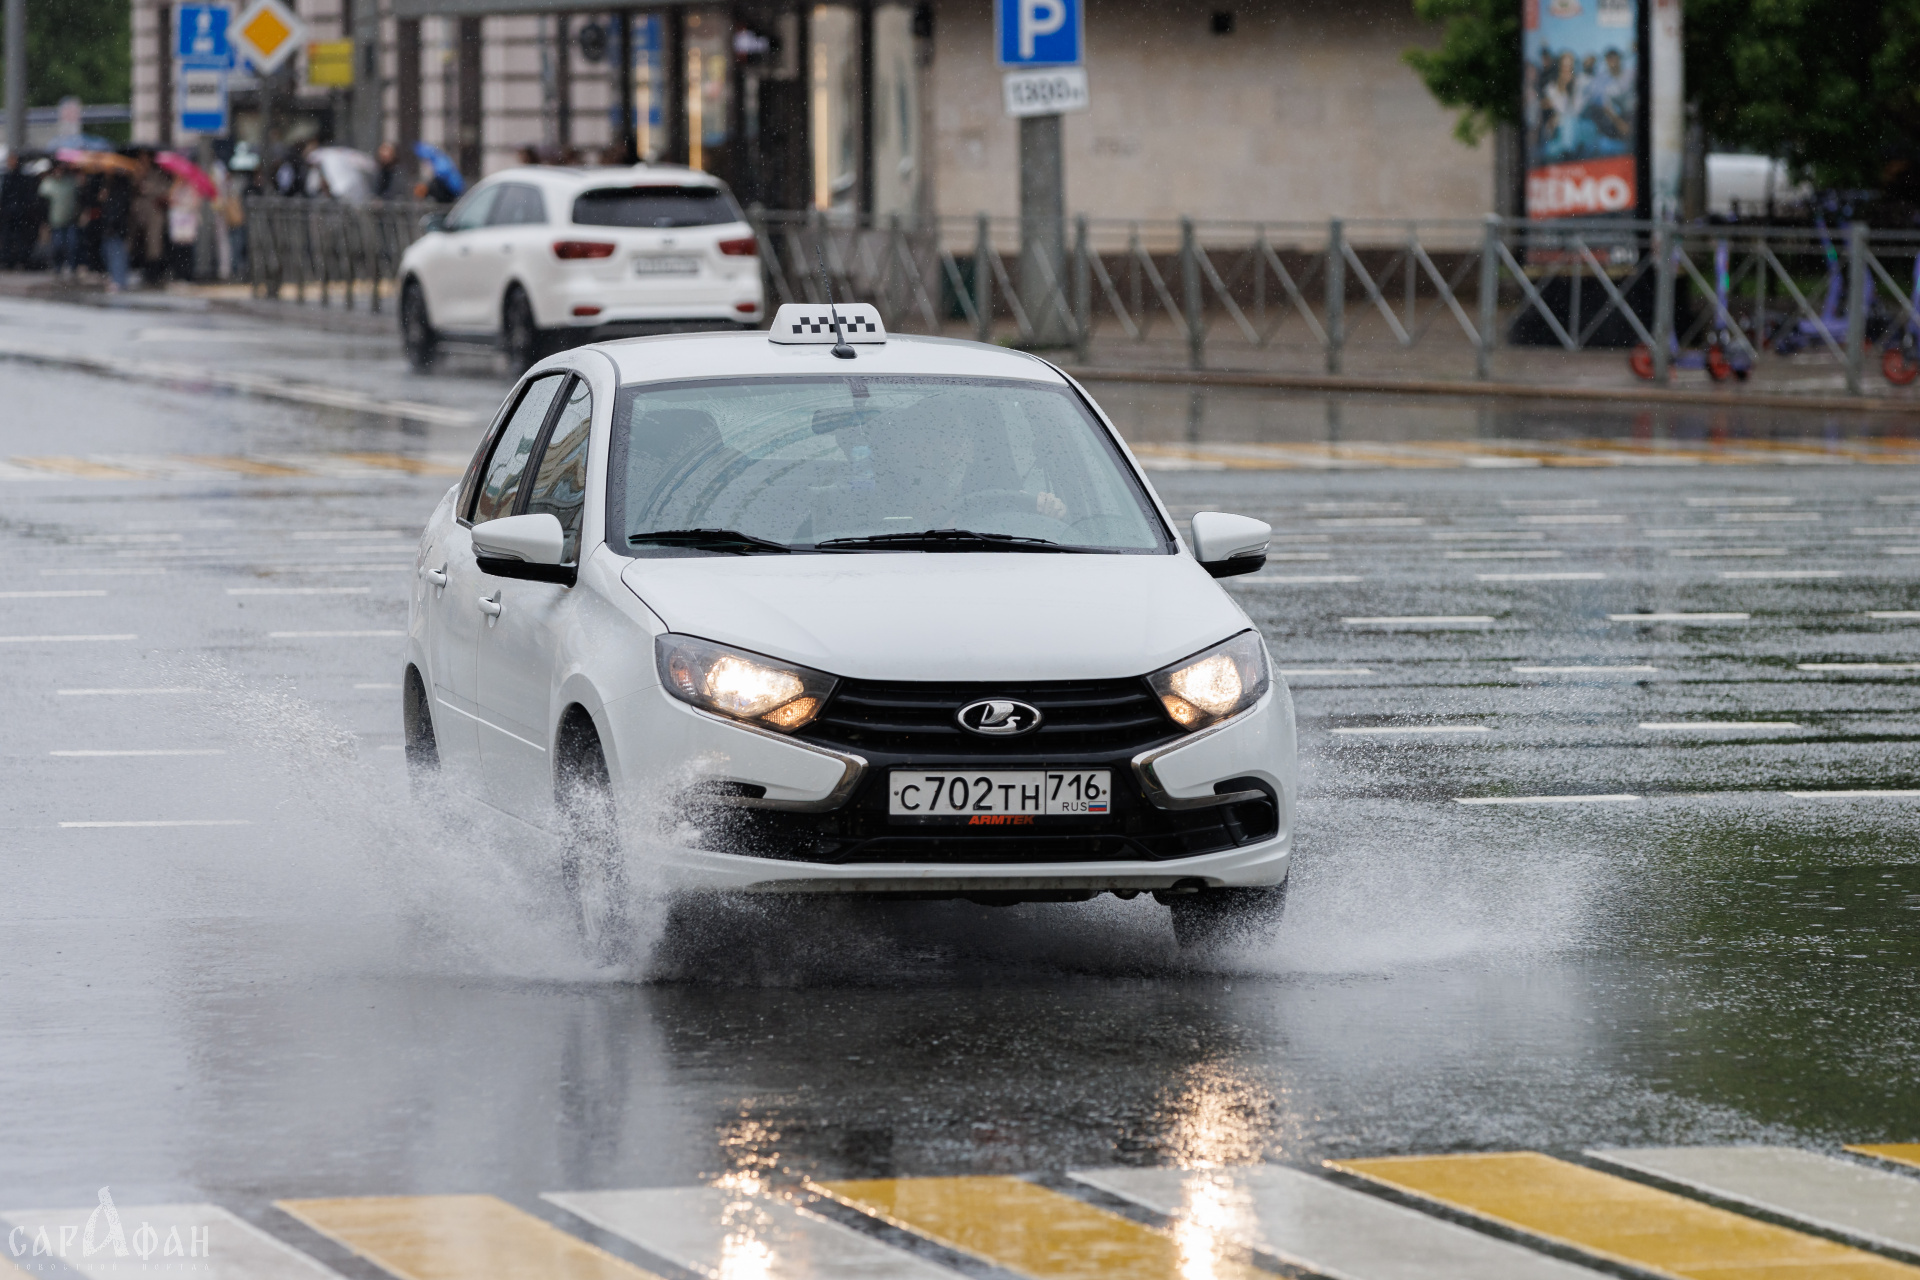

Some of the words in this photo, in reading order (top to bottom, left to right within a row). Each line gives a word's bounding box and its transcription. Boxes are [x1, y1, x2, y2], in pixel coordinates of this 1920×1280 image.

[1019, 0, 1066, 59] P
[1048, 774, 1100, 801] 716
[1062, 801, 1088, 812] RUS
[968, 815, 1034, 825] ARMTEK
